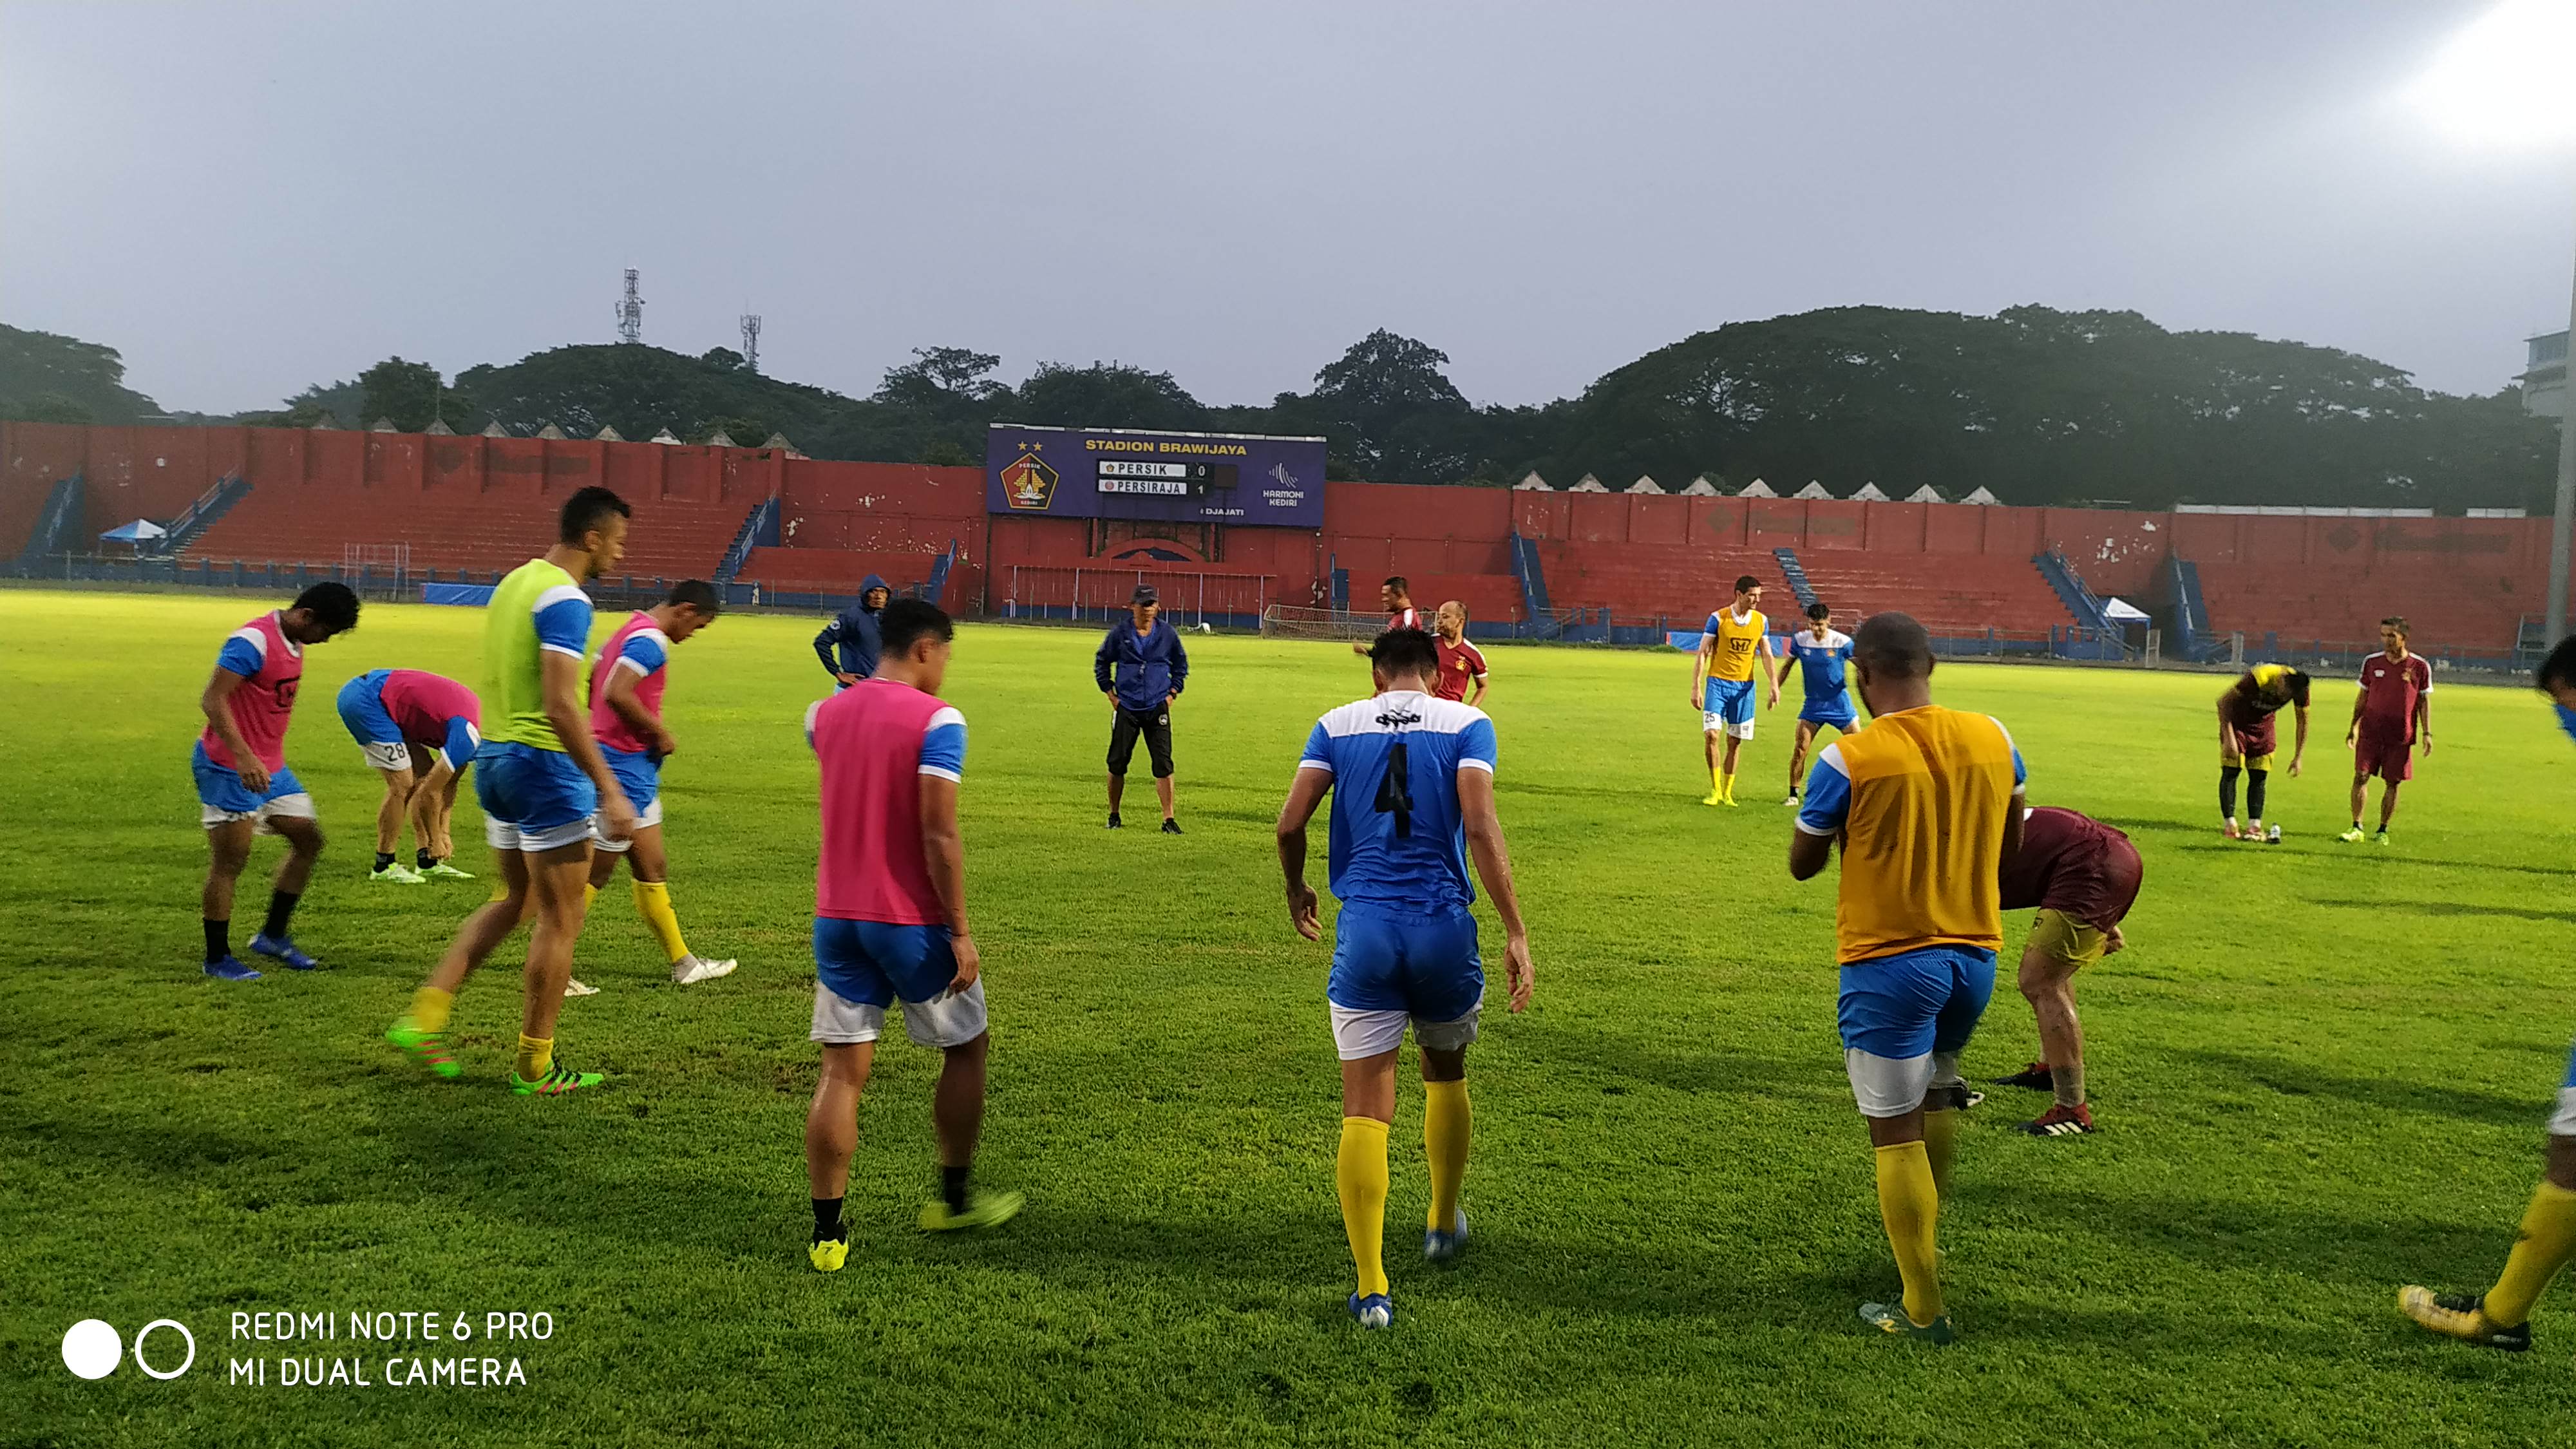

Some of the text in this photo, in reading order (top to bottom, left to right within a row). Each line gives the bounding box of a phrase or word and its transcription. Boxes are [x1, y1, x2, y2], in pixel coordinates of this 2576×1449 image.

[1086, 440, 1247, 455] STADION BRAWIJAYA
[1118, 463, 1206, 477] PERSIK 0
[1117, 482, 1204, 495] PERSIRAJA 1
[1263, 489, 1304, 498] HARMONI
[1269, 498, 1298, 507] KEDIRI
[1206, 507, 1244, 516] DJAJATI
[1705, 713, 1715, 723] 25
[384, 743, 406, 762] 28
[1374, 743, 1414, 840] 4
